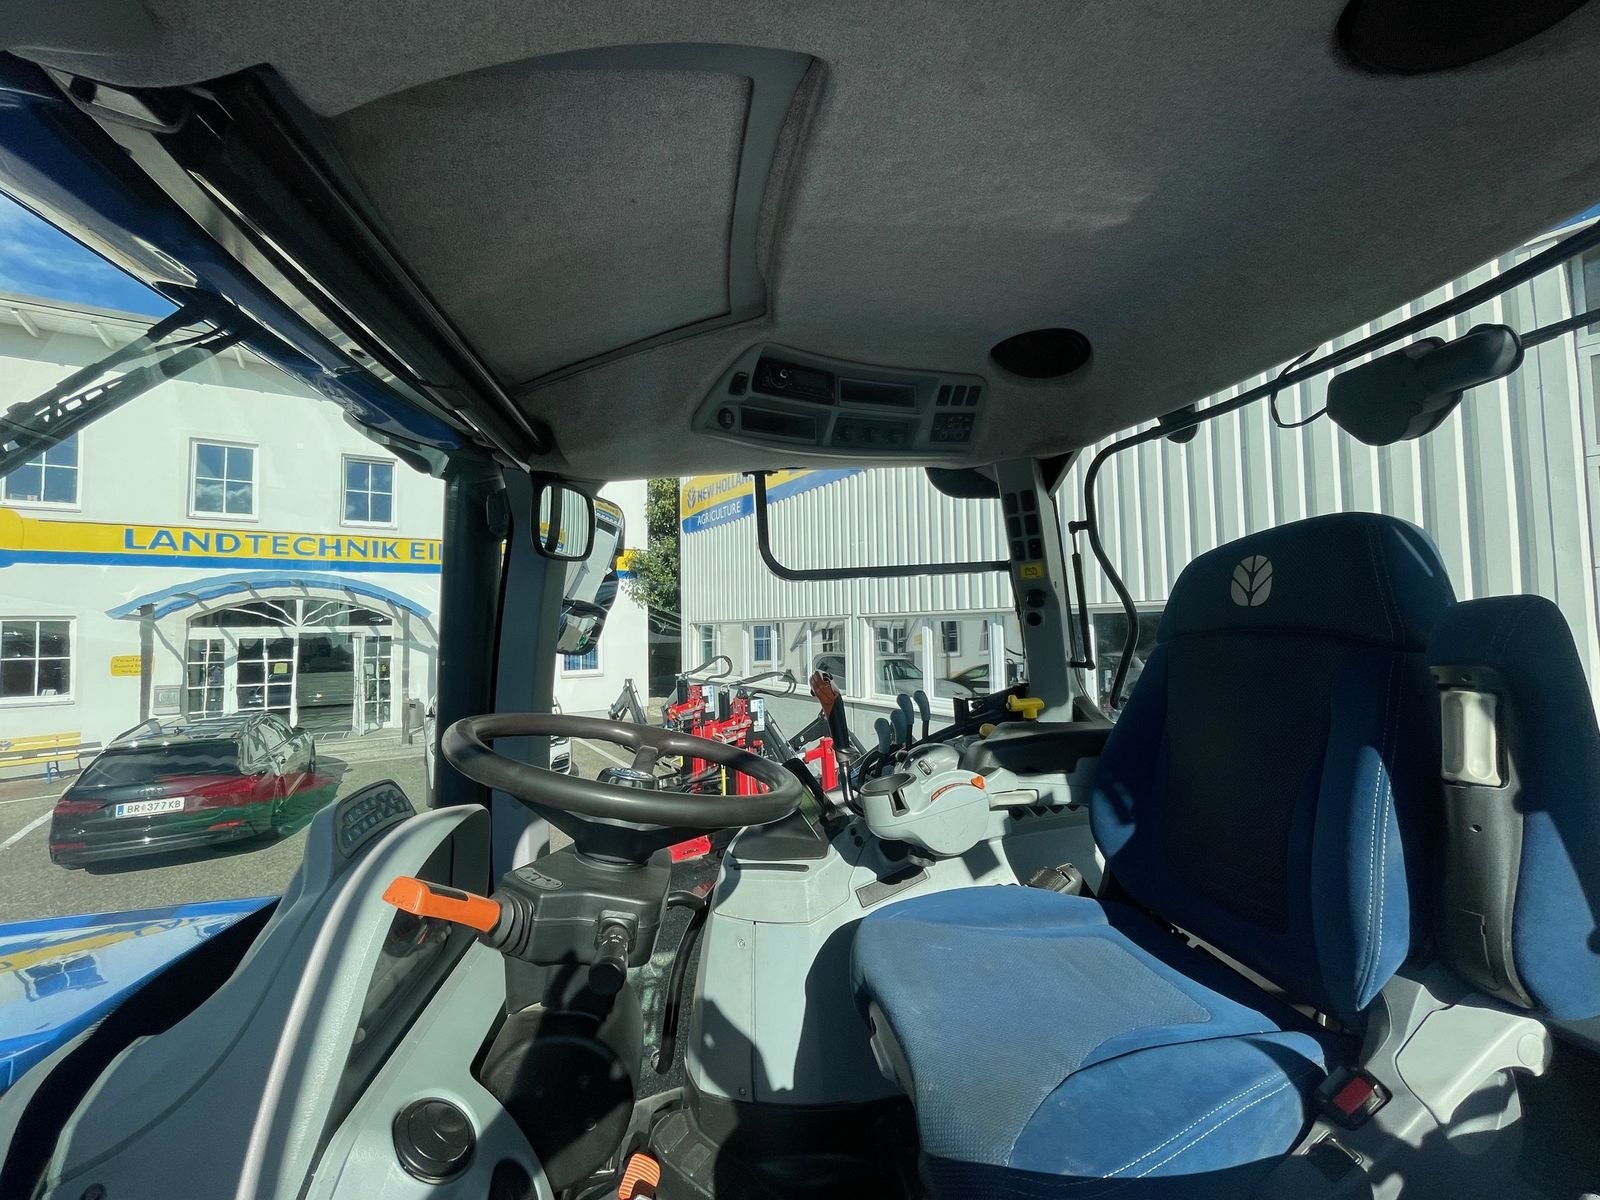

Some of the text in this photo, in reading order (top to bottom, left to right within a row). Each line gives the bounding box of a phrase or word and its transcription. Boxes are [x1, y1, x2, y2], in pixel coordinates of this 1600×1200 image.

[697, 482, 714, 503] NEW
[697, 501, 741, 526] AGRICULTURE
[124, 527, 400, 560] LANDTECHNIK
